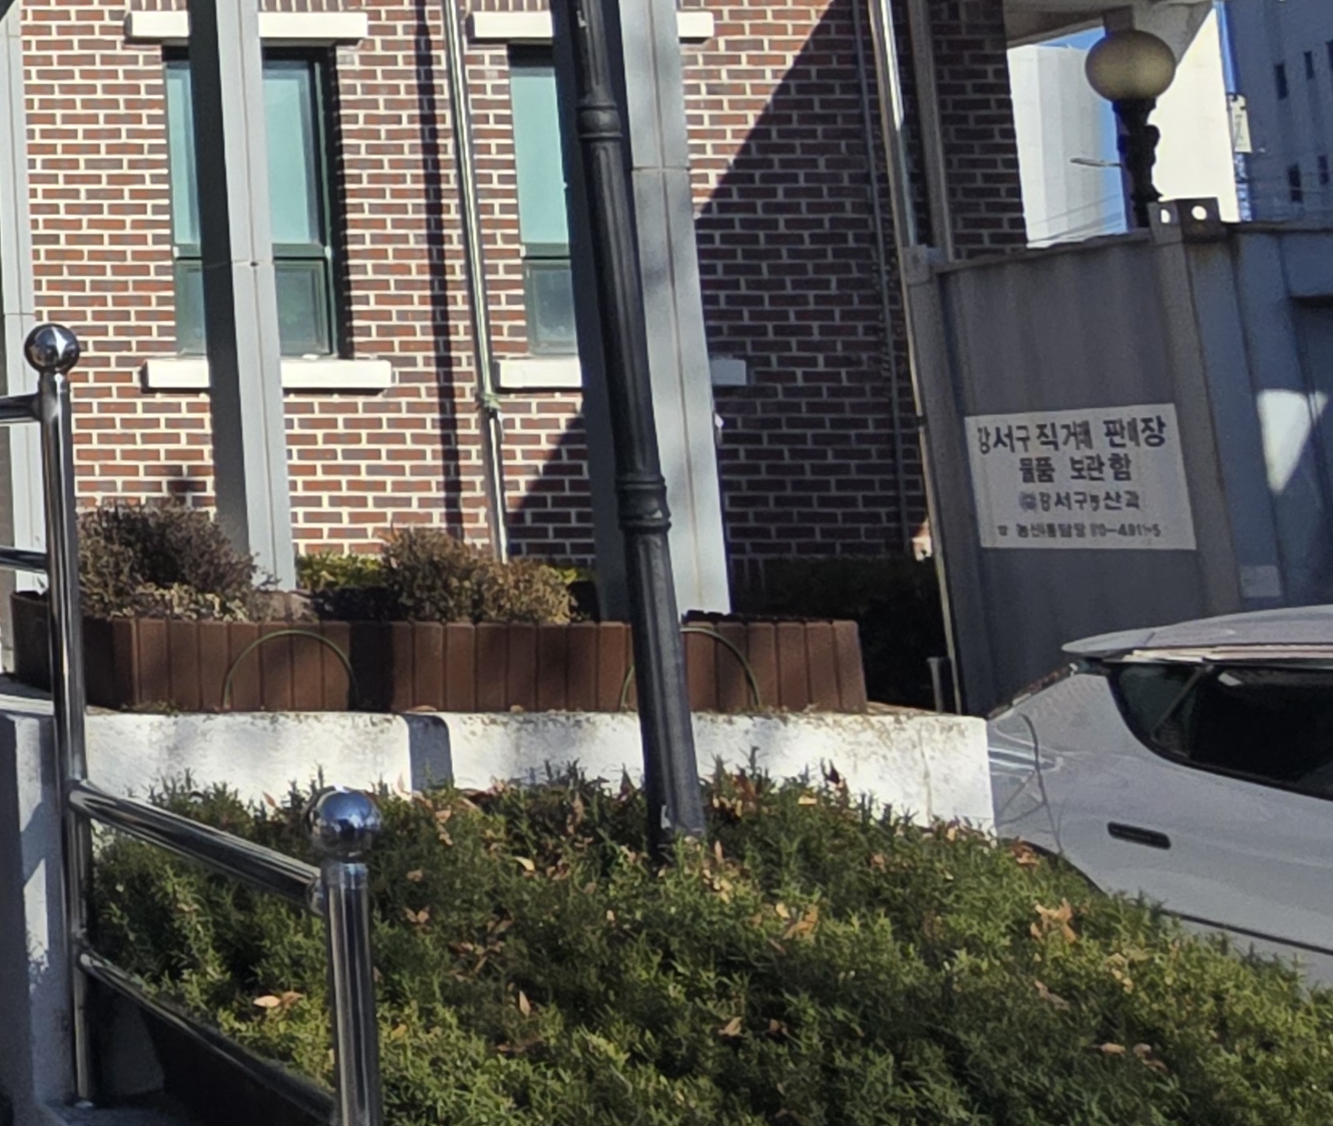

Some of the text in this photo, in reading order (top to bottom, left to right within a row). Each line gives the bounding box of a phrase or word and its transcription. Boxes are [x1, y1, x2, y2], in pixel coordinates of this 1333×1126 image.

[977, 423, 1031, 456] 강서구
[1019, 452, 1132, 484] 물품 보관함
